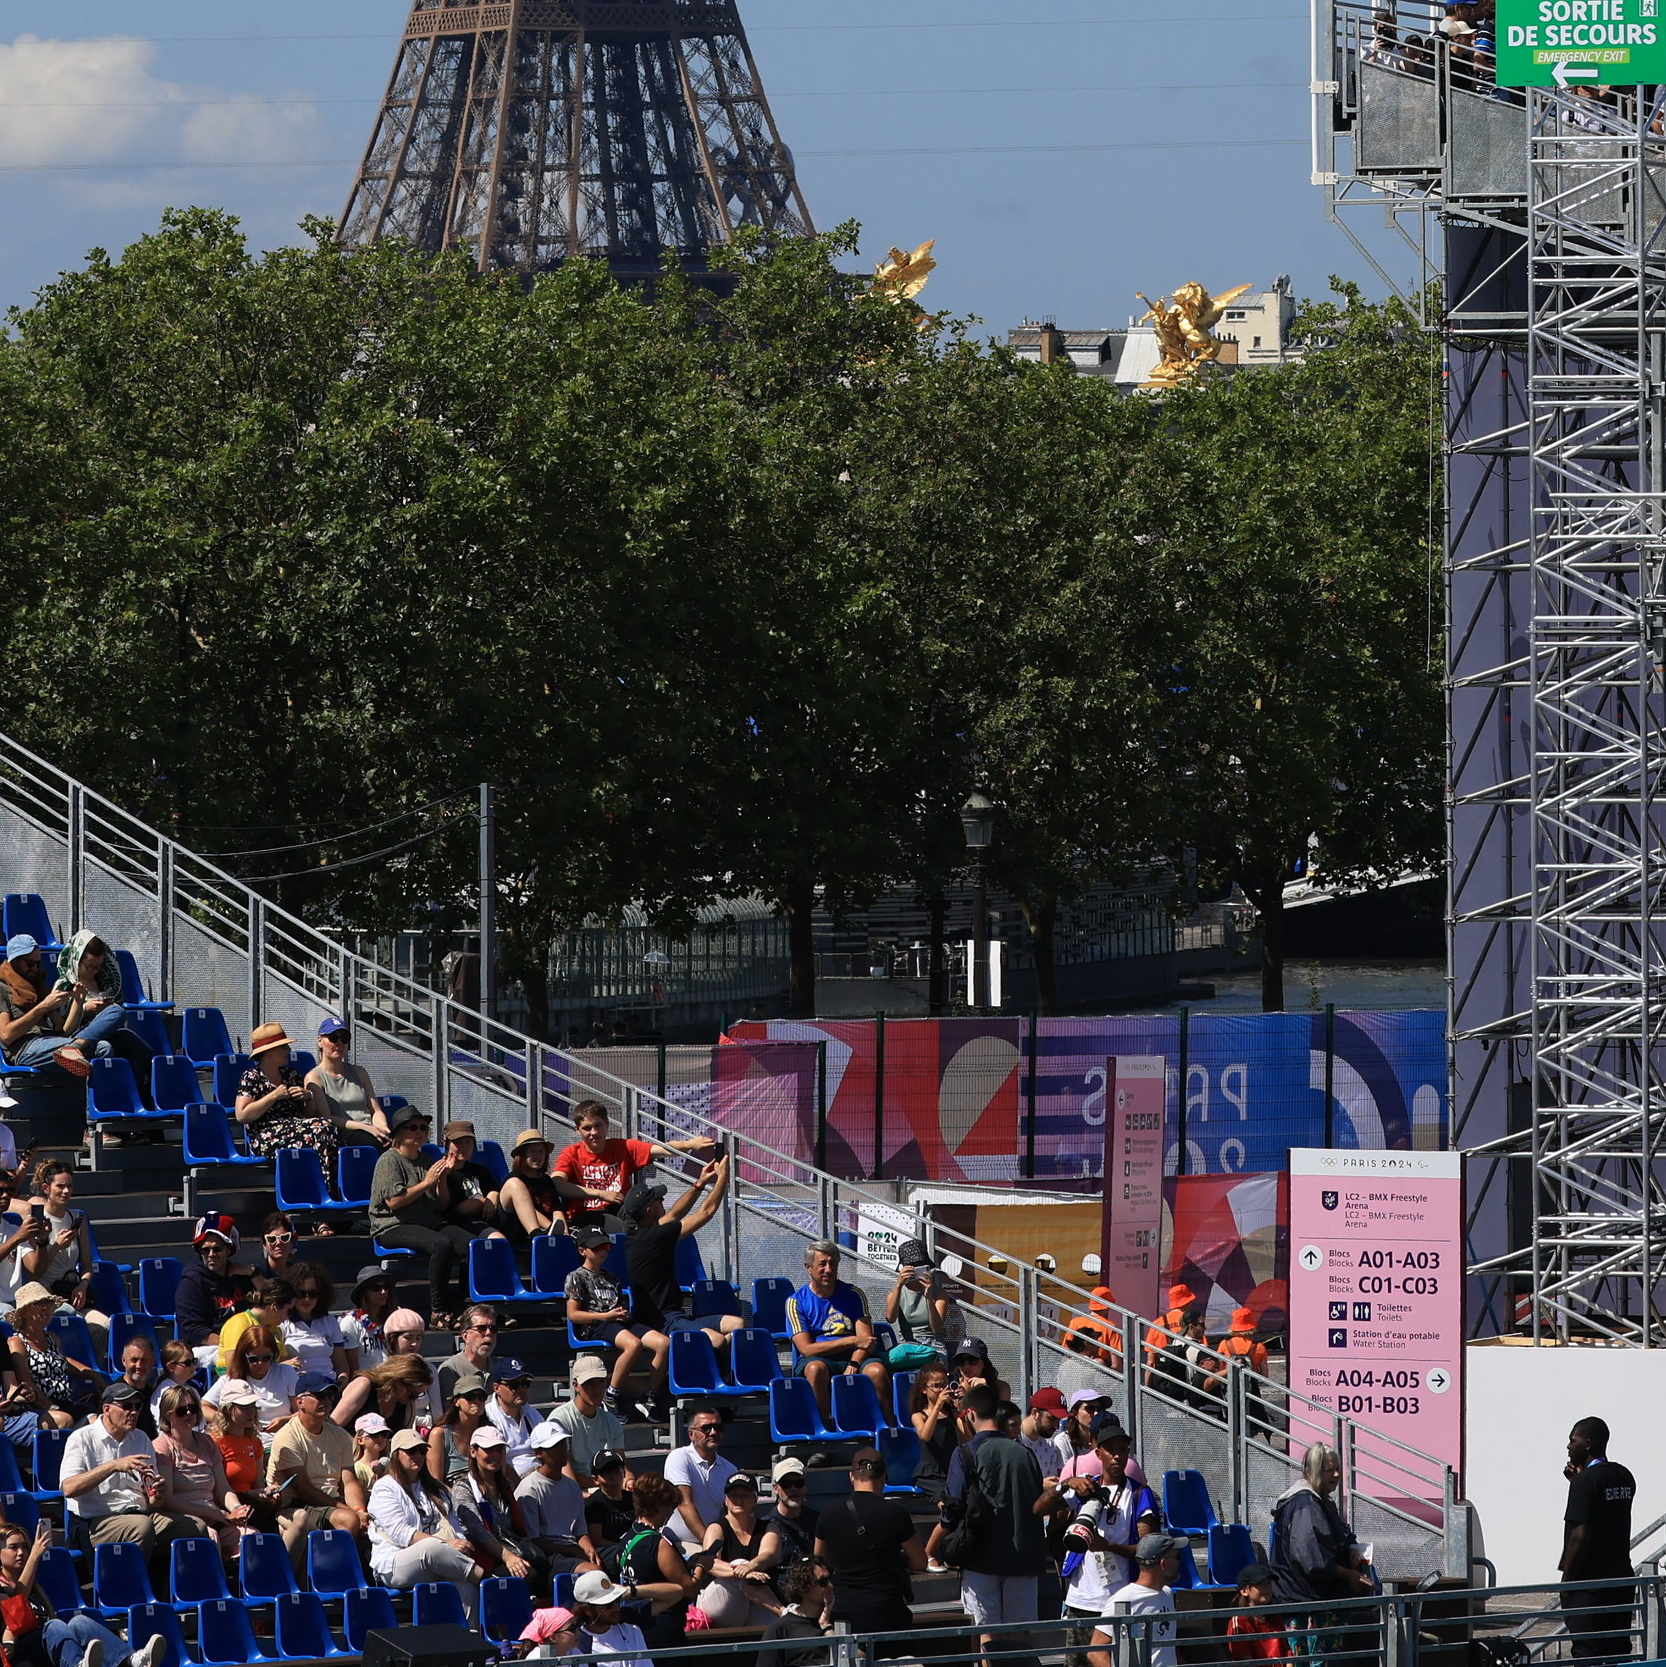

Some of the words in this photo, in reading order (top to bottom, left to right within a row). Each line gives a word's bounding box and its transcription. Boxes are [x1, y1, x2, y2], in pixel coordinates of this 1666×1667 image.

[1538, 0, 1625, 22] SORTIE
[1507, 25, 1538, 47] DE
[1544, 23, 1657, 47] SECOURS
[1537, 50, 1601, 63] EMERGENCY
[1602, 50, 1626, 62] EXIT
[1343, 1159, 1377, 1168] PARIS
[1381, 1160, 1412, 1169] 2024
[1345, 1193, 1360, 1201] LC2
[1369, 1193, 1388, 1202] BMX
[1390, 1194, 1428, 1203] Freestyle
[1345, 1202, 1369, 1210] Arena
[1344, 1211, 1359, 1219] LC2
[1368, 1212, 1386, 1220] BMX
[1389, 1212, 1424, 1221] Freestyle
[1344, 1220, 1368, 1228] Arena
[1329, 1249, 1351, 1258] Blocs
[1328, 1259, 1354, 1267] Blocks
[1358, 1250, 1440, 1269] A01-A03
[1329, 1275, 1351, 1284] Blocs
[1328, 1285, 1354, 1293] Blocks
[1358, 1276, 1439, 1295] C01-C03
[1377, 1303, 1412, 1312] Toilettes
[1377, 1313, 1403, 1322] Toilets
[1353, 1330, 1382, 1338] Station
[1384, 1331, 1407, 1339] d'eau
[1409, 1332, 1440, 1341] potable
[1352, 1340, 1375, 1348] Water
[1377, 1340, 1406, 1349] Station
[1309, 1368, 1331, 1377] Blocs
[1305, 1378, 1331, 1386] Blocks
[1335, 1369, 1420, 1389] A04-A05
[1311, 1394, 1333, 1403] Blocs
[1338, 1395, 1420, 1415] B01-B03
